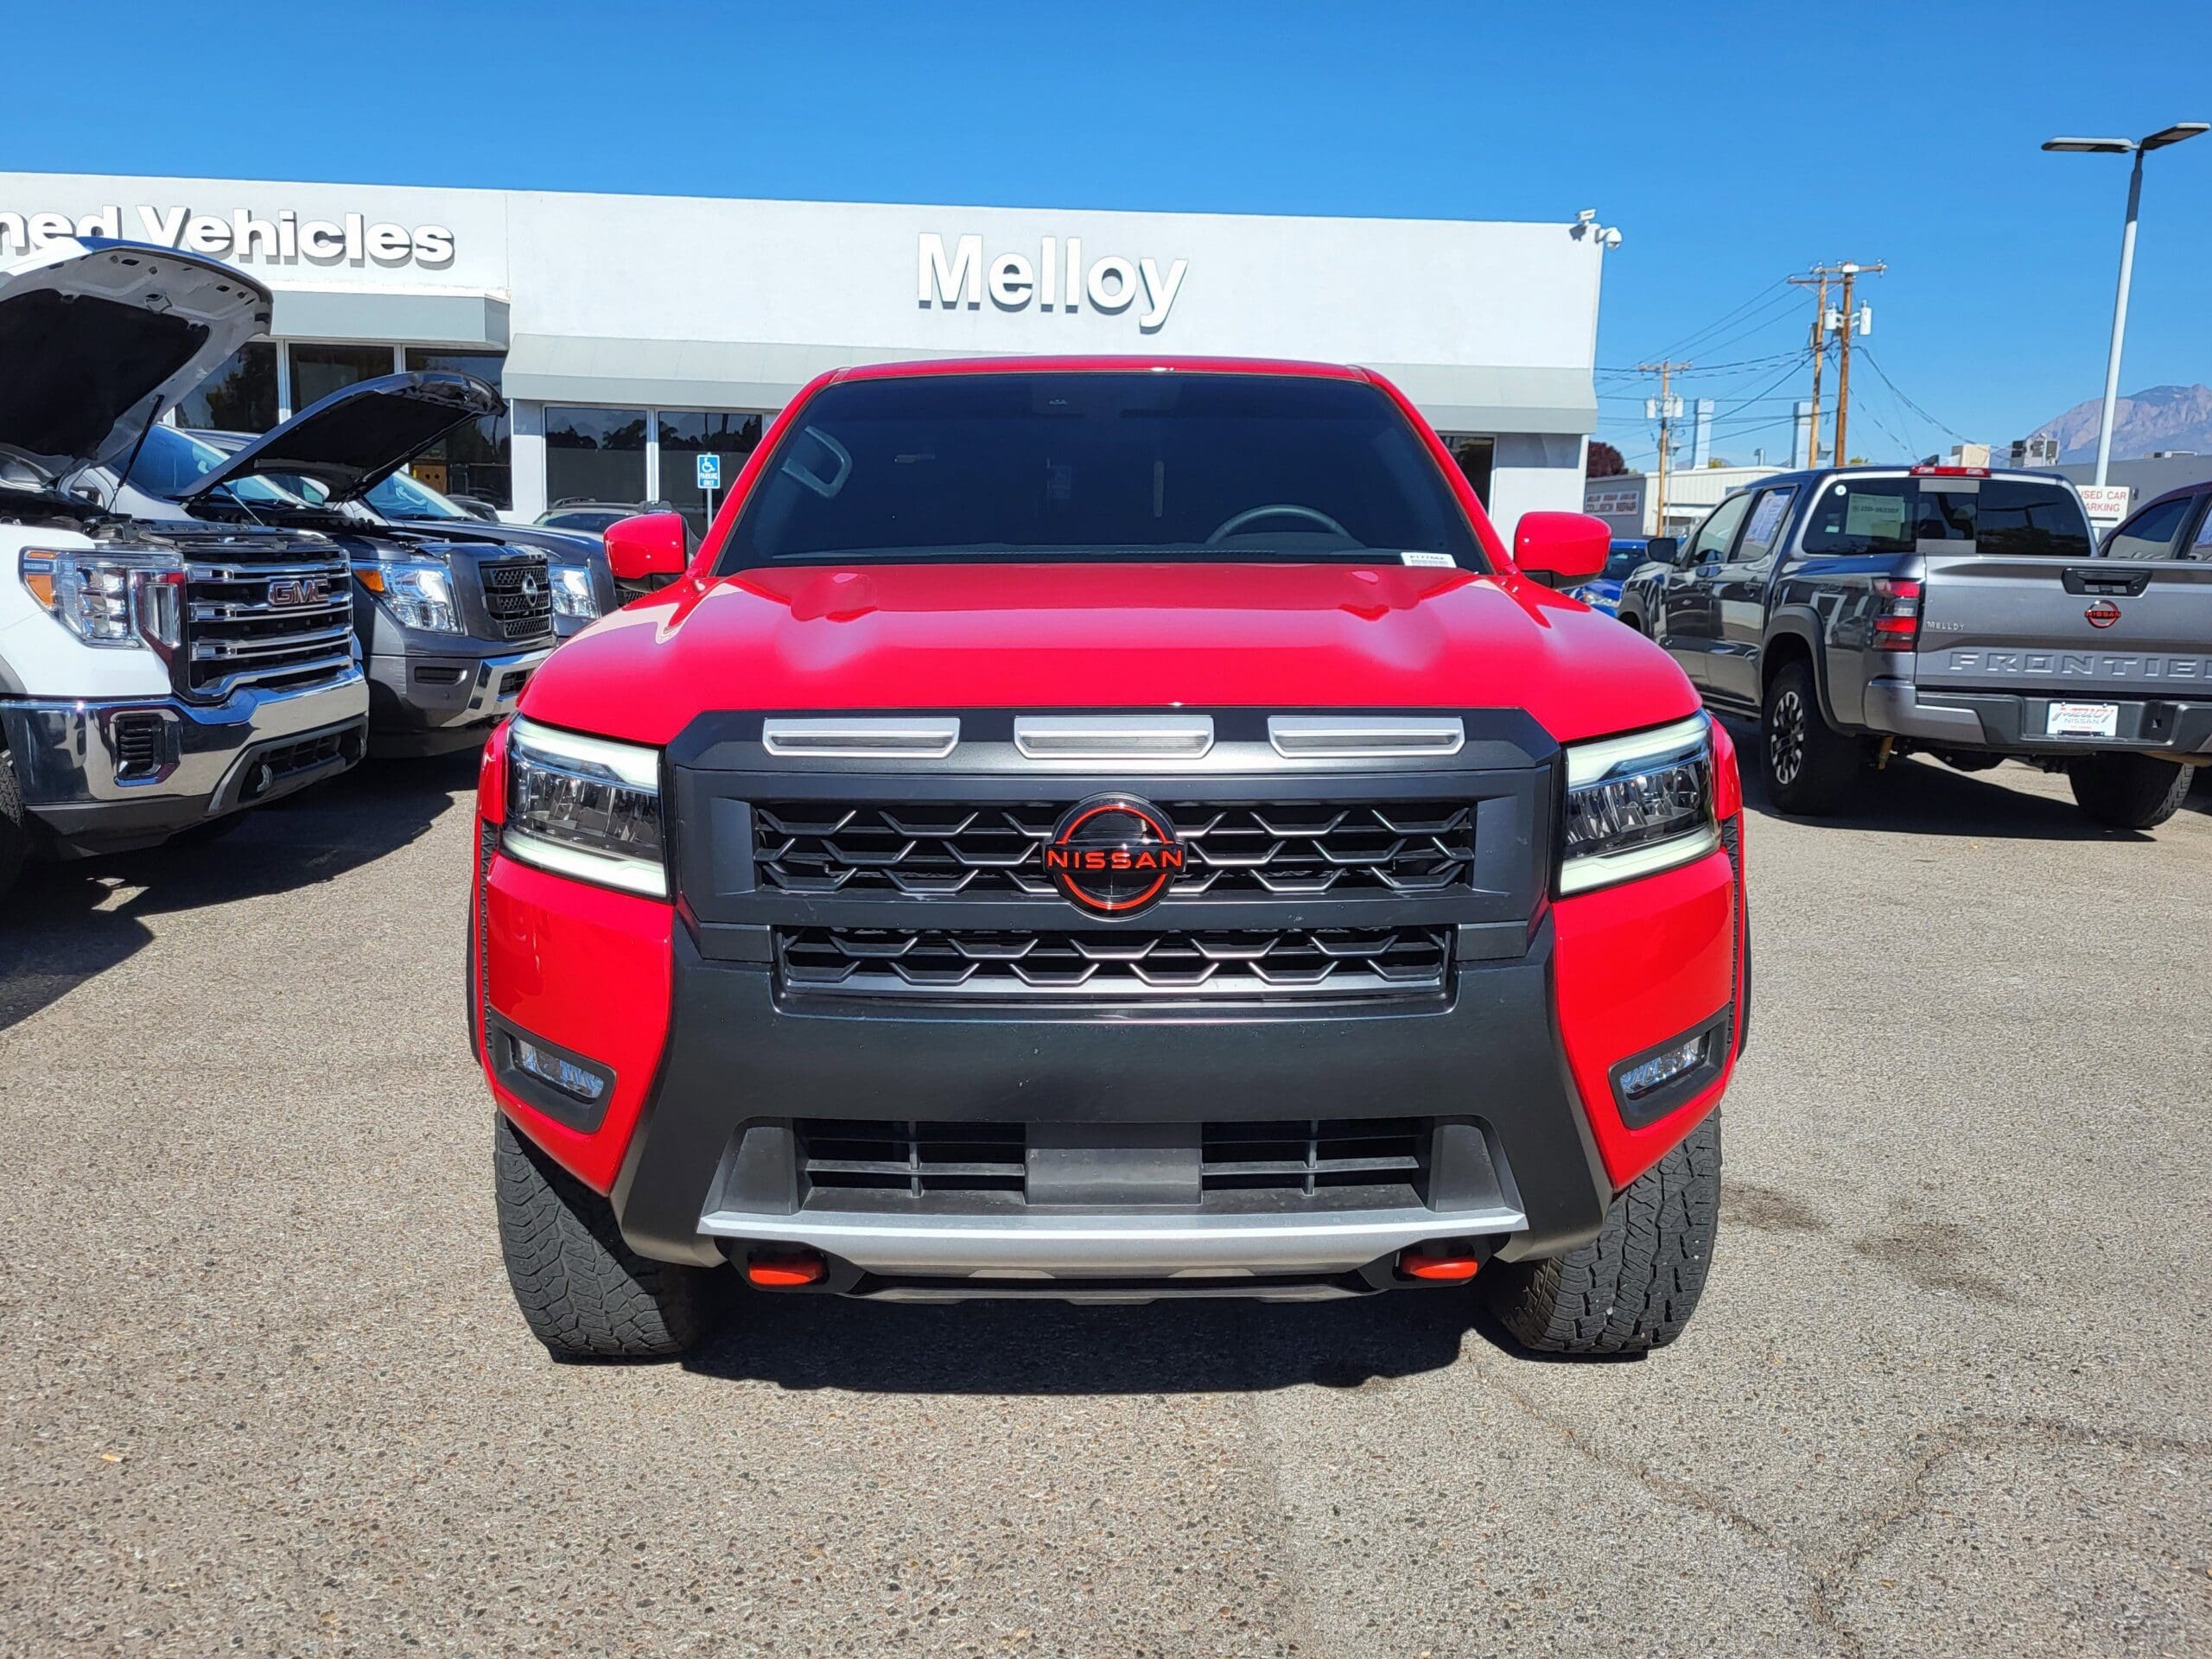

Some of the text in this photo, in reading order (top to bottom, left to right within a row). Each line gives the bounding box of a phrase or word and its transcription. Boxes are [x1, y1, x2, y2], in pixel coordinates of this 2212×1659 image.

[137, 203, 454, 269] Vehicles
[918, 232, 1189, 334] Melloy
[2107, 491, 2126, 500] CAR
[2085, 502, 2120, 512] ARKING
[268, 578, 329, 605] GMC
[2085, 609, 2120, 618] NISSAN
[1046, 849, 1183, 869] NISSAN
